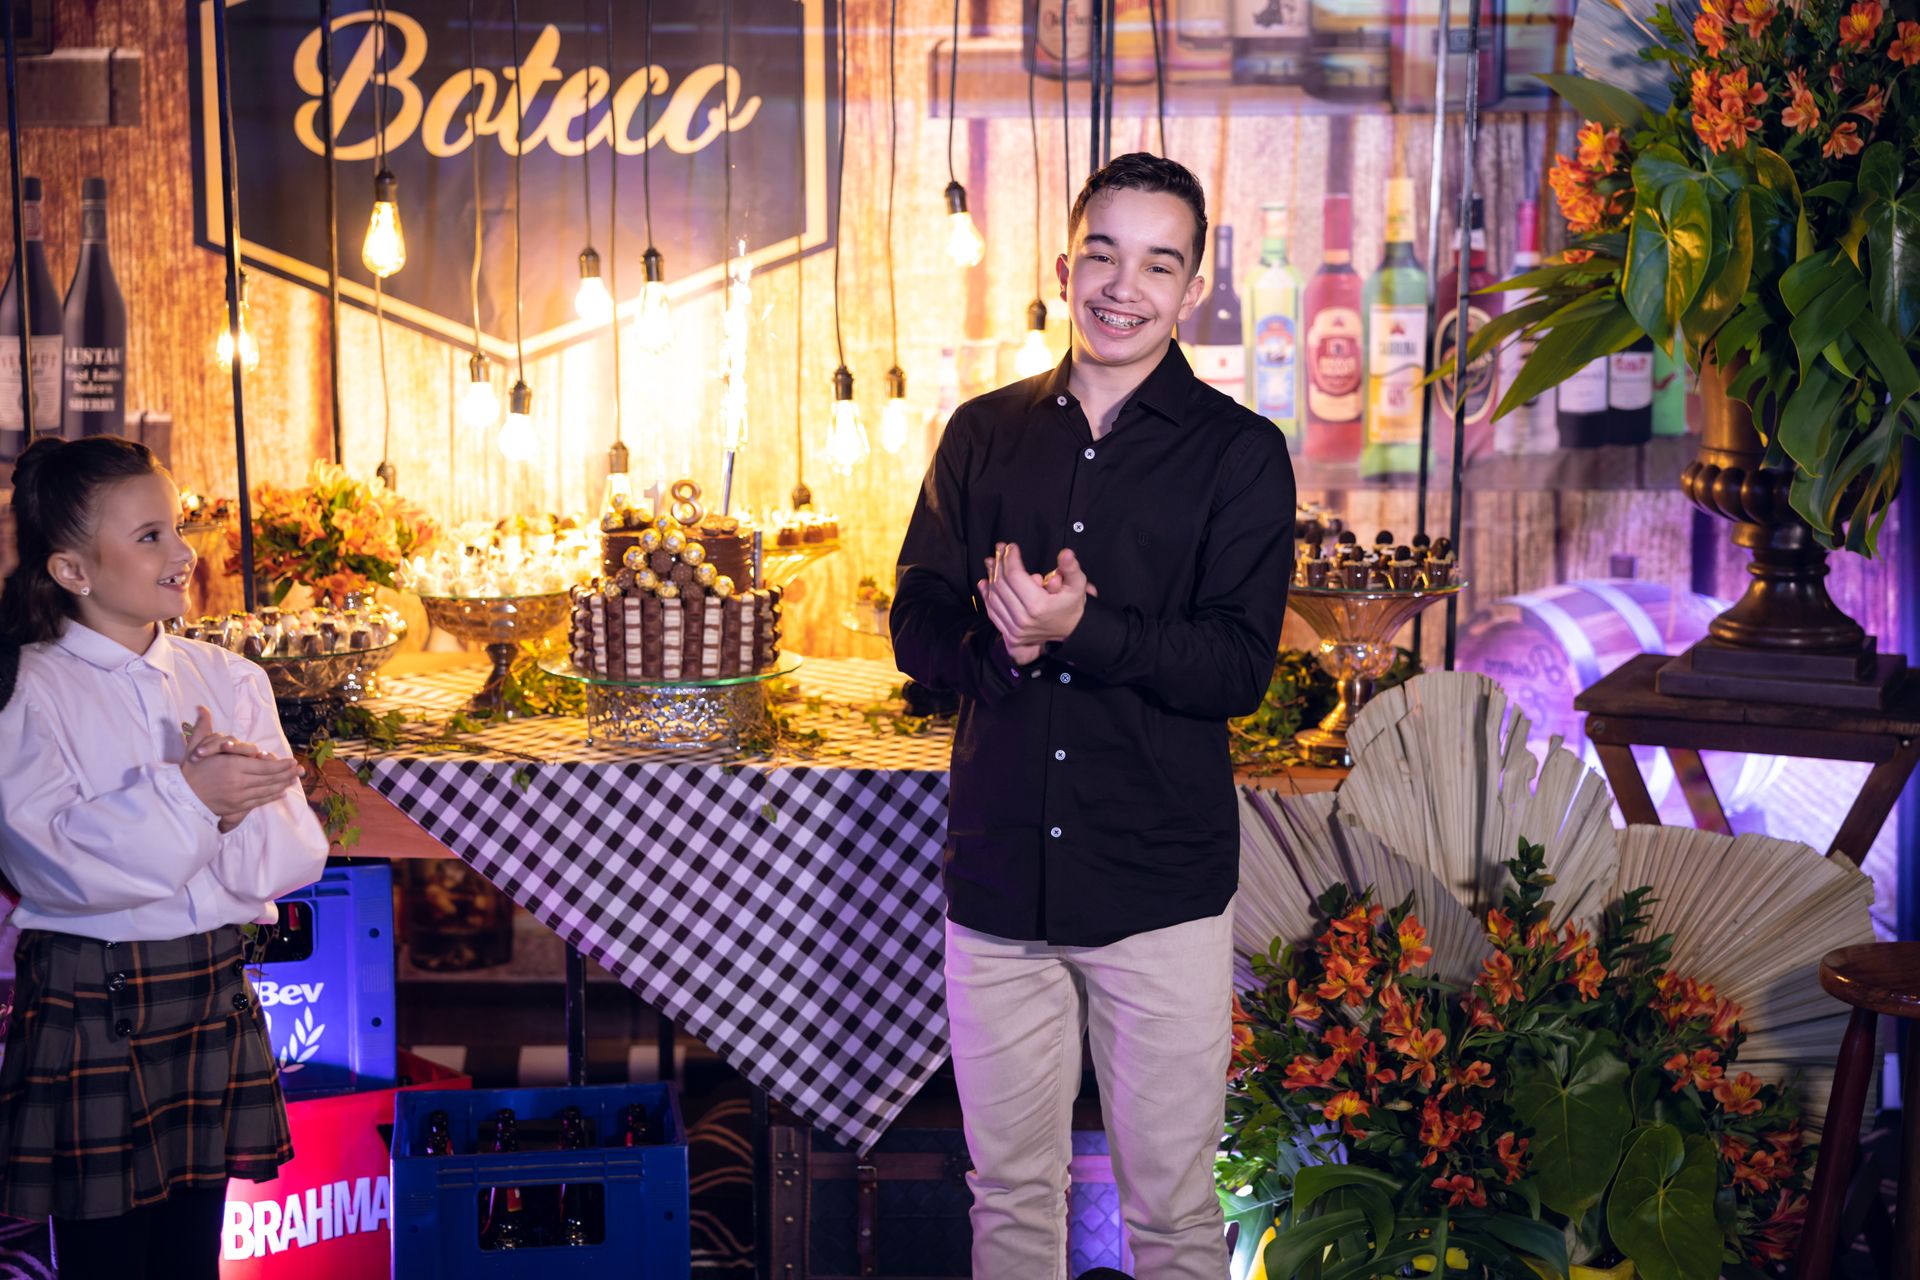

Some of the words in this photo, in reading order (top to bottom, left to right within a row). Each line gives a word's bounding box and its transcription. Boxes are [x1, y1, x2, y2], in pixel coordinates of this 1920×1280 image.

[294, 9, 761, 161] Boteco
[644, 480, 703, 526] 18
[222, 1175, 391, 1261] BRAHMA
